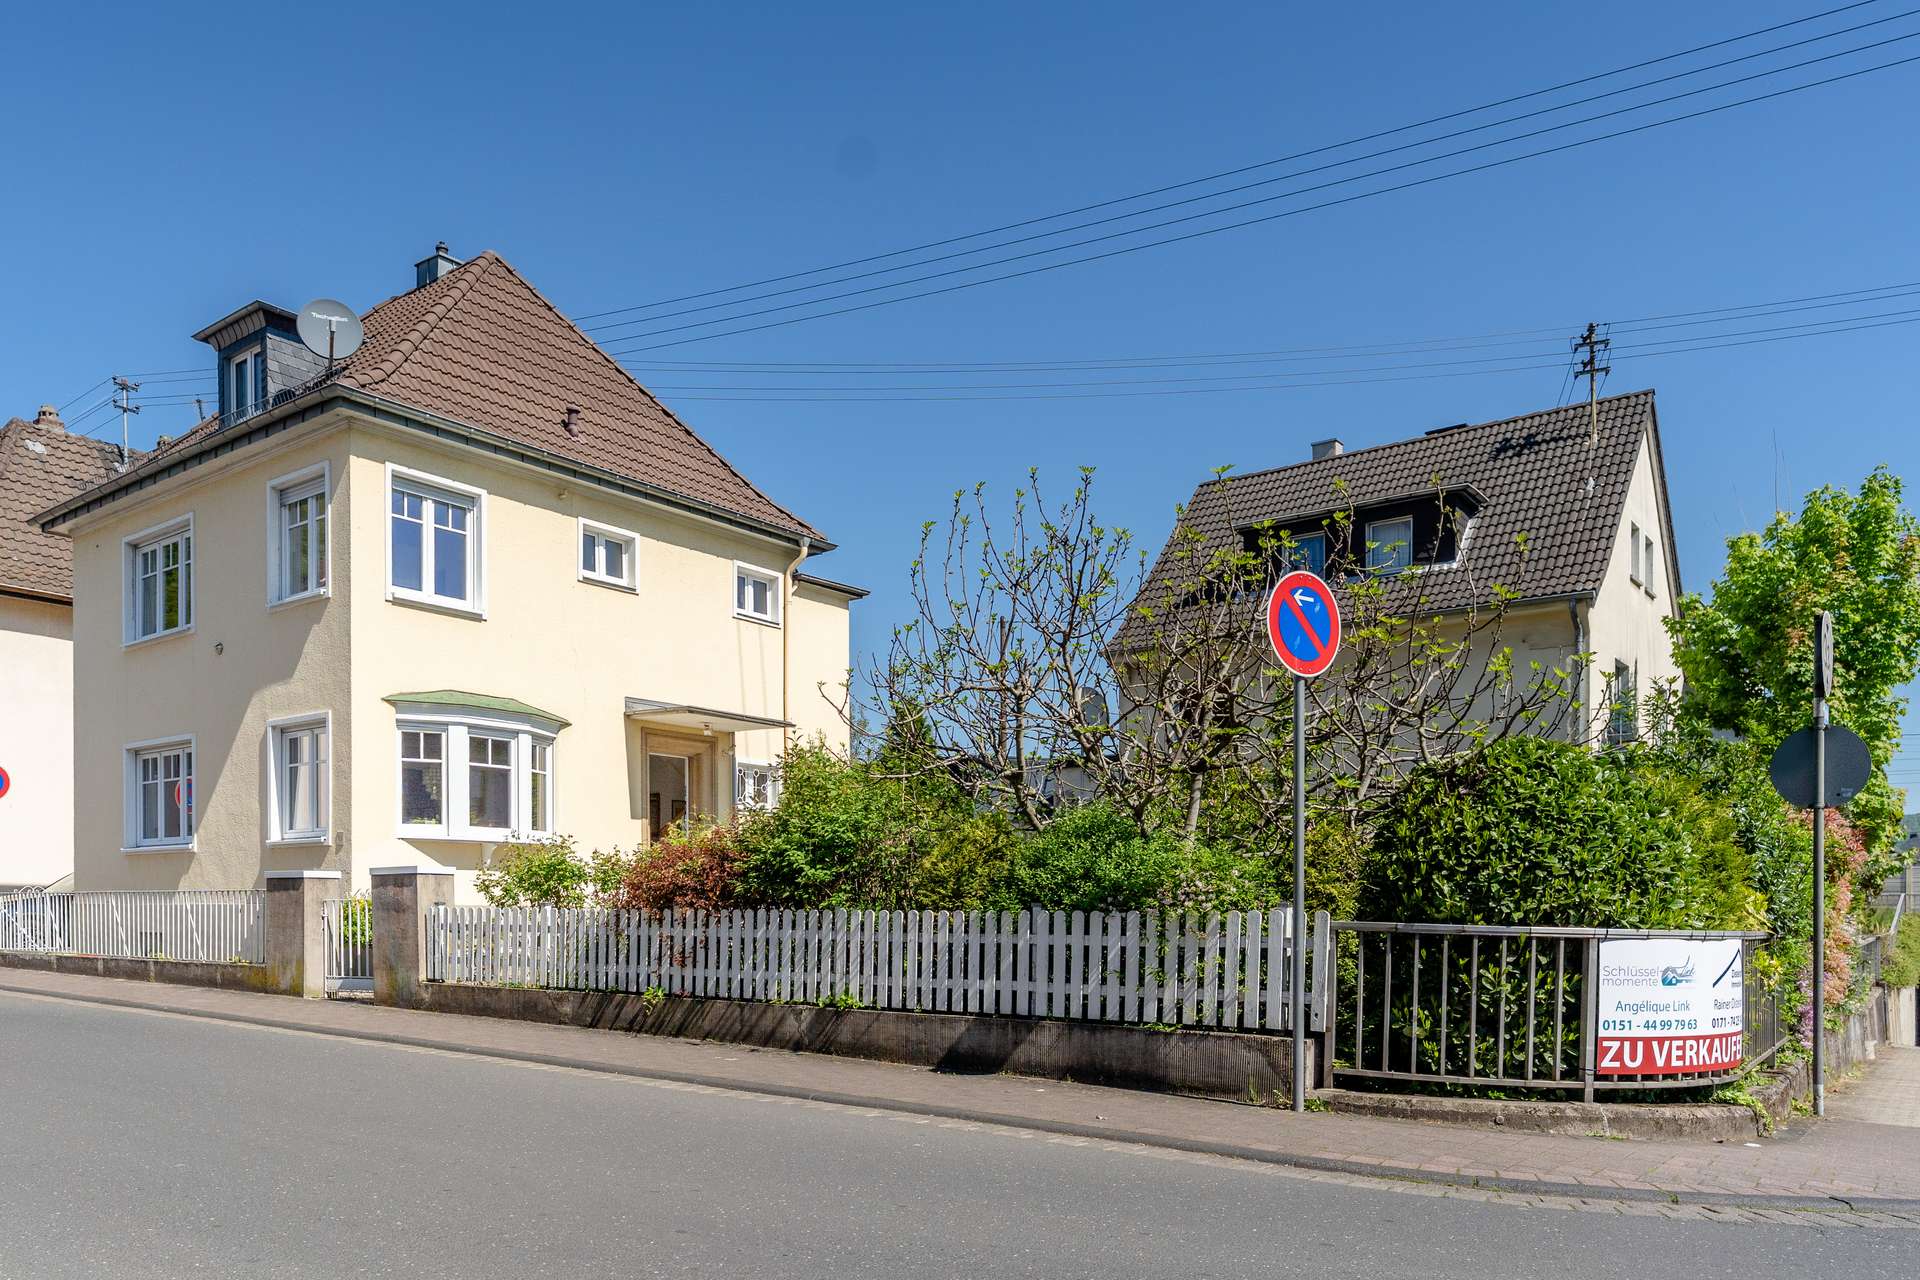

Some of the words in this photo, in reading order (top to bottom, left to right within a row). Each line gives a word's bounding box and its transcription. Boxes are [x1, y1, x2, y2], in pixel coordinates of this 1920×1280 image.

[1602, 978, 1658, 987] momente
[1616, 1000, 1671, 1015] Angélique
[1673, 1000, 1690, 1012] Link
[1602, 1019, 1632, 1031] 0151
[1643, 1019, 1657, 1031] 44
[1660, 1019, 1672, 1031] 99
[1675, 1019, 1685, 1031] 79
[1687, 1018, 1698, 1030] 63
[1600, 1040, 1644, 1068] ZU
[1651, 1034, 1742, 1067] VERKAUFE
